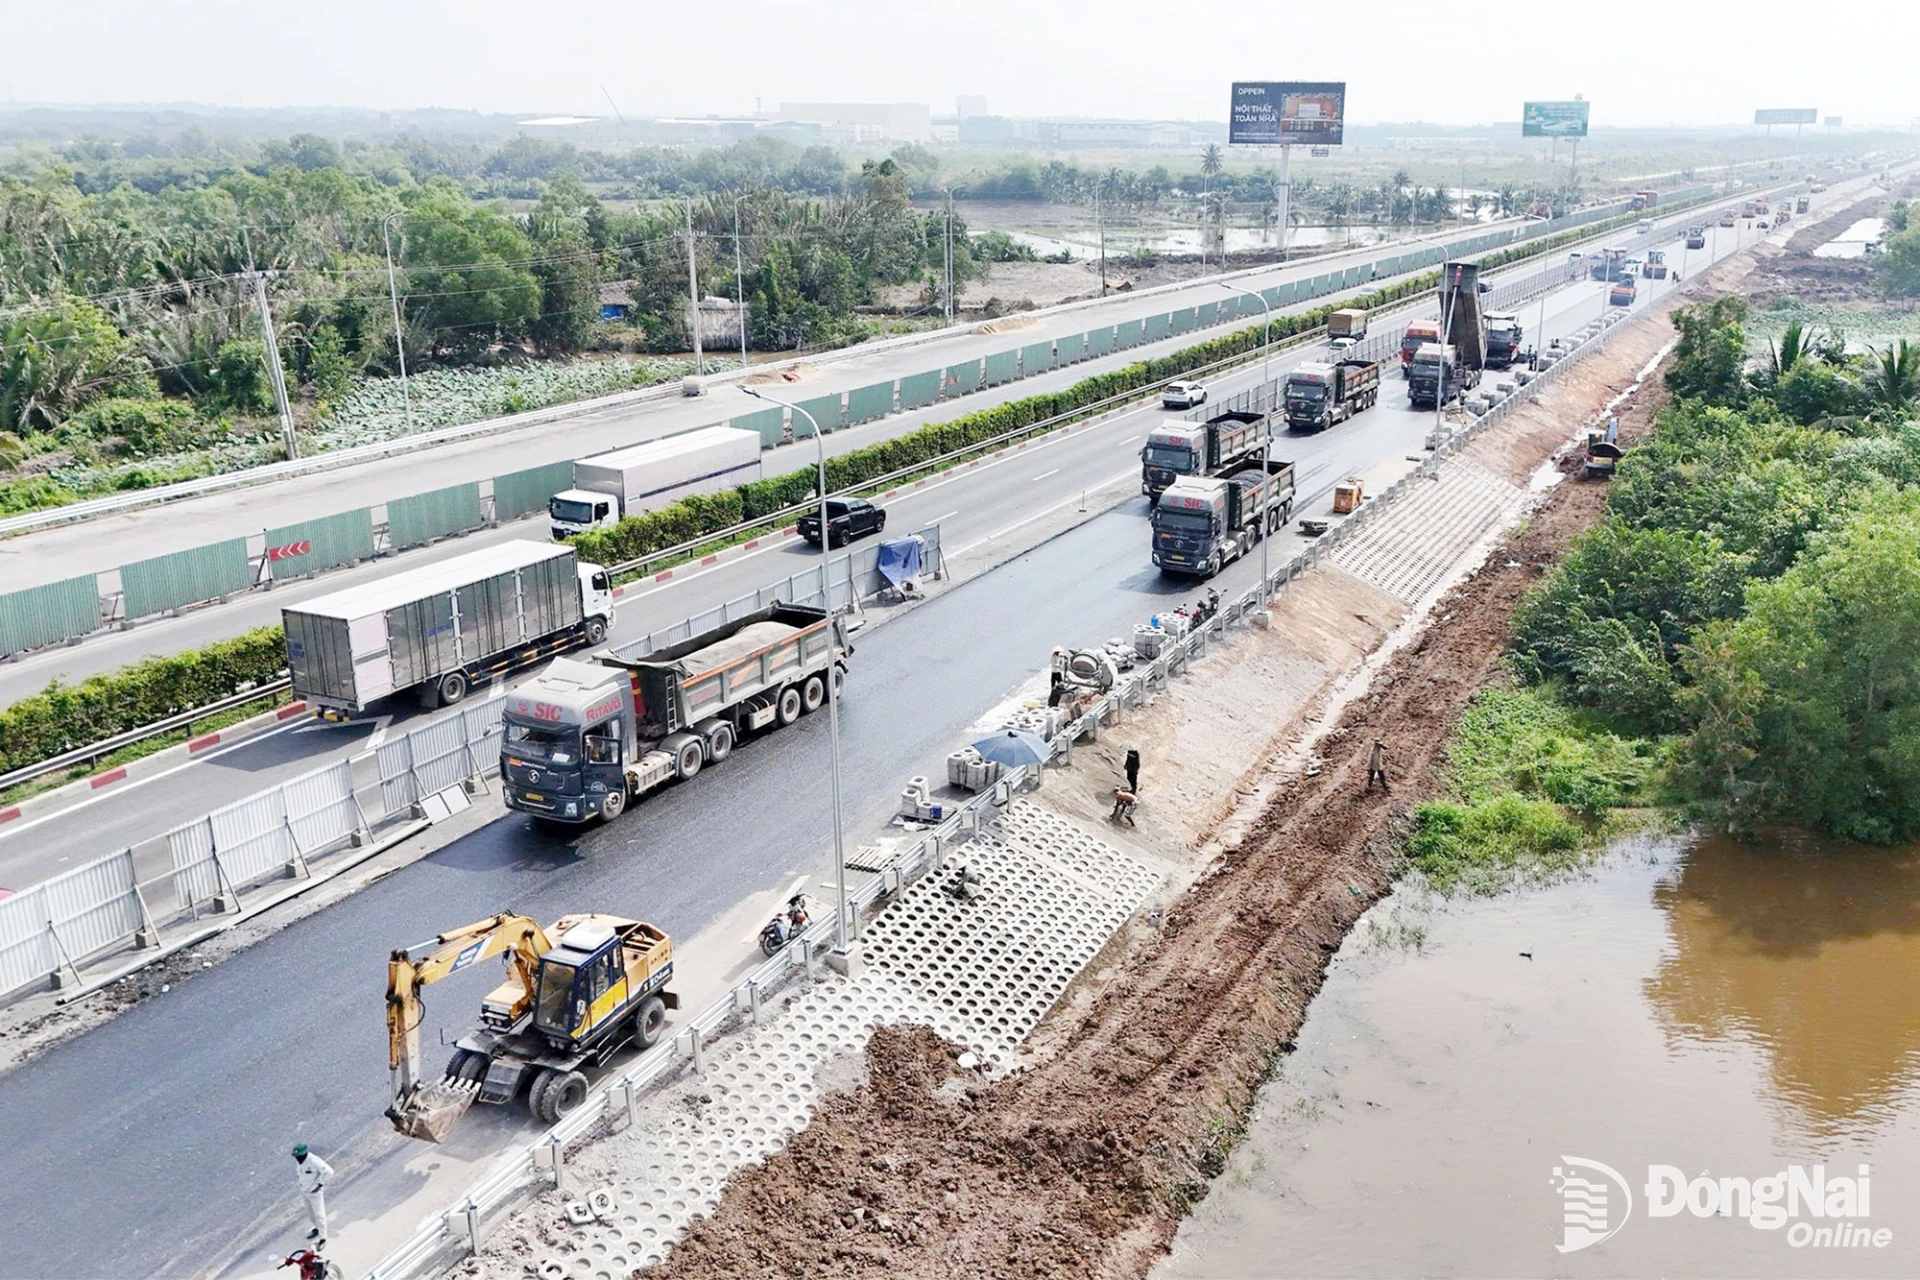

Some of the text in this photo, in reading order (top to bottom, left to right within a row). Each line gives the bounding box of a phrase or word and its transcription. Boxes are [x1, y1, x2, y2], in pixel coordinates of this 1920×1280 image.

[1235, 103, 1273, 114] NỘI THẤT
[1168, 435, 1185, 447] SIC
[1183, 497, 1204, 510] SIC
[533, 701, 563, 722] SIC
